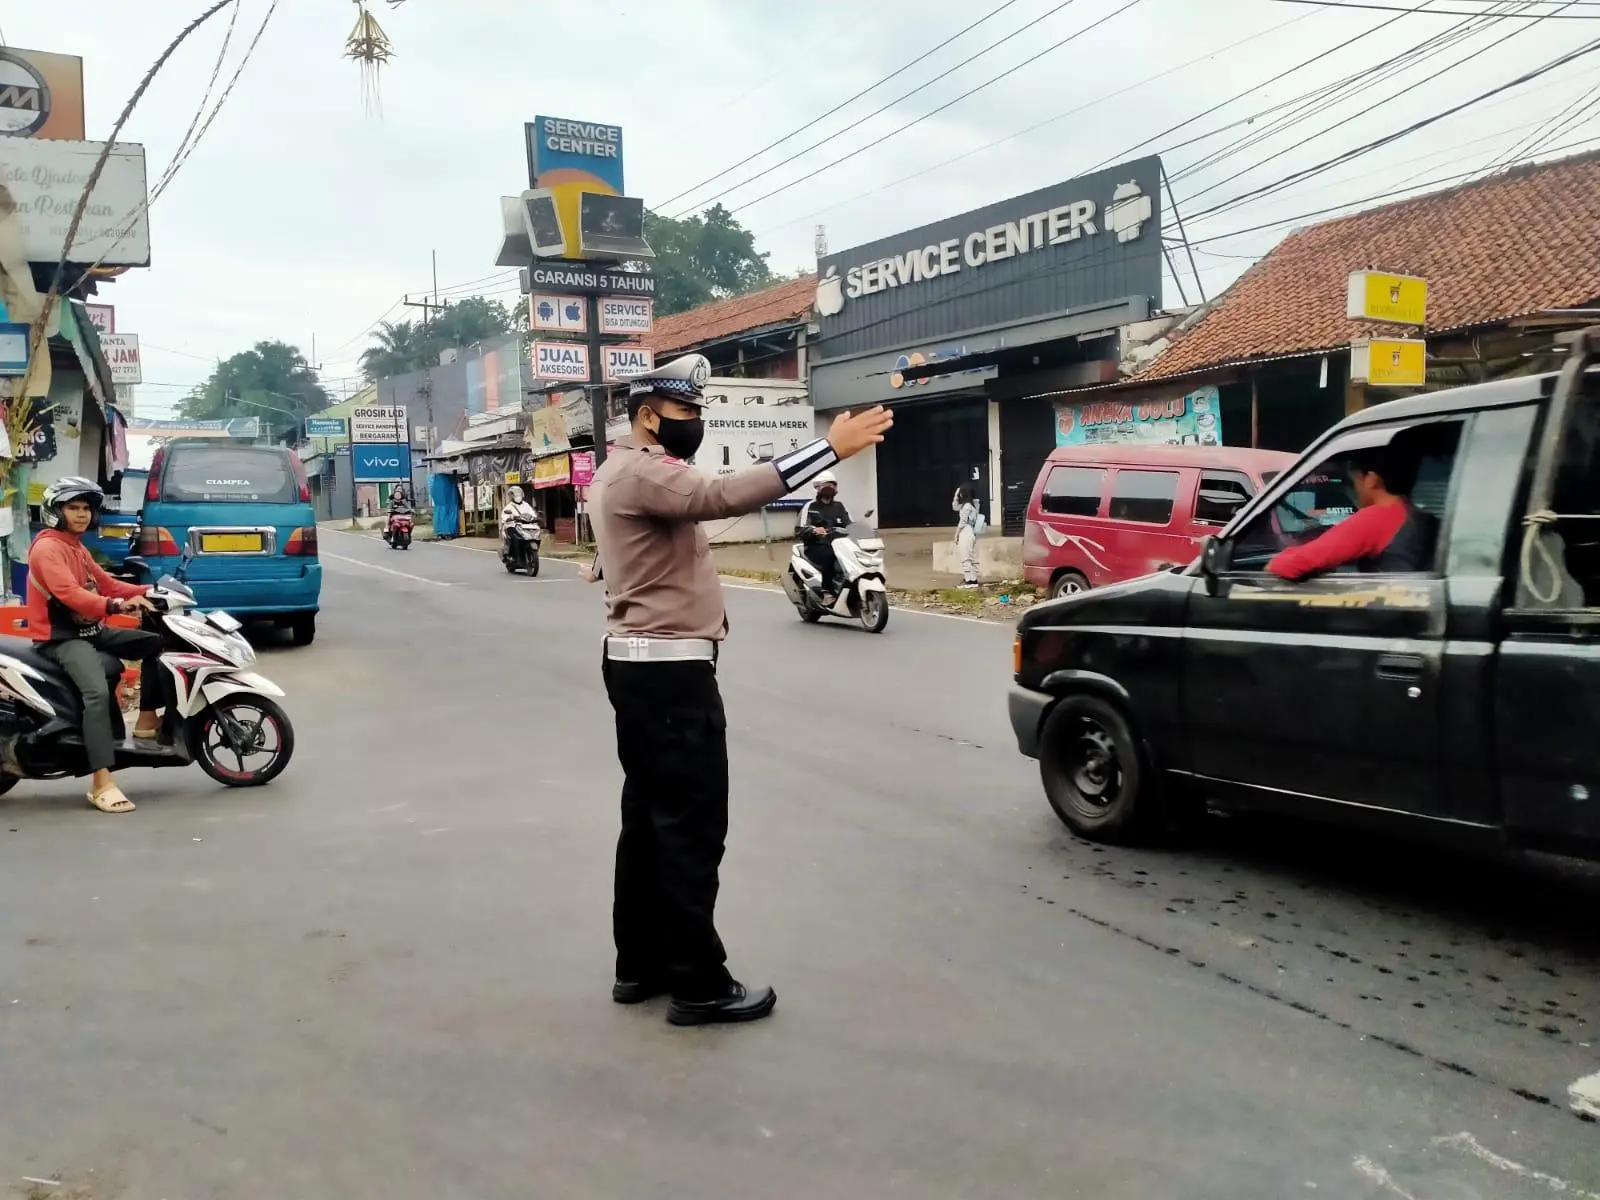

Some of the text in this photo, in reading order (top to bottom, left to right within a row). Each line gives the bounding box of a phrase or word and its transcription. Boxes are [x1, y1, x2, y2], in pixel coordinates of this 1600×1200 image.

[544, 119, 618, 142] SERVICE
[546, 137, 617, 158] CENTER
[847, 200, 1099, 299] SERVICE CENTER
[534, 270, 654, 291] GARANSI 5 TAHUN
[605, 303, 647, 316] SERVICE
[605, 318, 619, 326] BISA
[113, 349, 138, 364] JAM
[540, 349, 584, 364] JUAL
[610, 352, 647, 367] JUAL
[540, 364, 585, 376] AKSESORIS
[355, 408, 387, 418] GROSIR
[708, 419, 808, 429] SERVICE SEMUA MEREK
[363, 457, 400, 467] vivo
